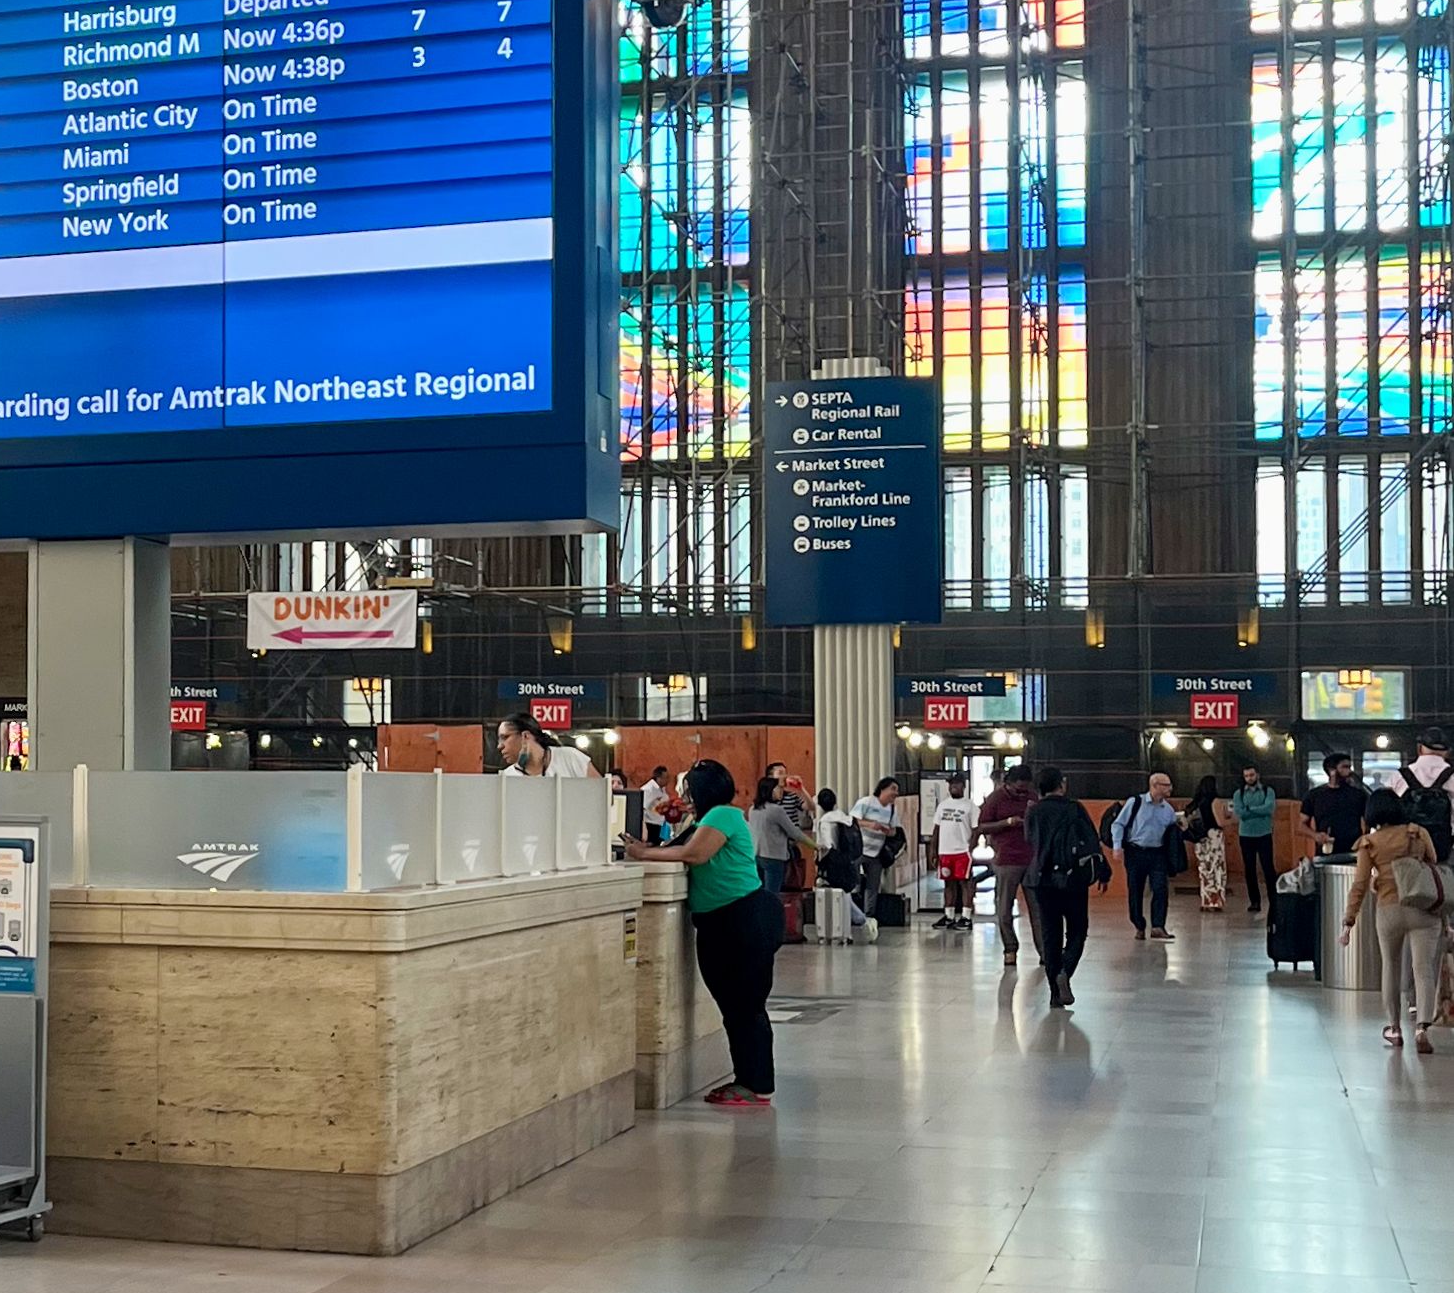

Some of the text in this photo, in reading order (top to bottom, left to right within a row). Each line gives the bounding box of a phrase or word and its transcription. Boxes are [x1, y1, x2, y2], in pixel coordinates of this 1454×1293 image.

[63, 4, 176, 33] Harrisburg
[63, 34, 172, 67] Richmond
[178, 32, 200, 55] M
[223, 27, 276, 50] Now
[281, 18, 345, 45] 4:36p
[411, 8, 426, 31] 7
[497, 0, 513, 23] 7
[62, 78, 139, 102] Boston
[223, 64, 277, 87] Now
[281, 55, 346, 81] 4:38p
[412, 45, 426, 68] 3
[496, 36, 514, 60] 4
[62, 107, 148, 136] Atlantic
[153, 103, 199, 130] City
[223, 98, 256, 121] On
[261, 93, 318, 117] Time
[62, 142, 129, 170] Miami
[223, 133, 256, 156] On
[261, 128, 318, 153] Time
[62, 173, 179, 208] Springfield
[223, 168, 256, 191] On
[261, 163, 318, 188] Time
[62, 216, 113, 238] New
[118, 209, 170, 233] York
[223, 203, 256, 226] On
[261, 198, 318, 223] Time
[76, 388, 119, 416] call
[126, 387, 163, 414] for
[169, 380, 266, 411] Amtrak
[274, 373, 407, 404] Northeast
[415, 364, 535, 401] Regional
[811, 392, 853, 406] SEPTA
[811, 404, 900, 422] Regional Rail
[811, 426, 882, 441] Car Rental
[791, 457, 885, 472] Market Street
[812, 479, 866, 492] Market-
[812, 492, 911, 507] Frankford Line
[812, 514, 896, 531] Trolley Lines
[812, 538, 851, 550] Buses
[272, 595, 390, 621] DUNKIN'
[170, 686, 218, 698] th Street
[517, 683, 585, 695] 30th Street
[910, 680, 983, 693] 30th Street
[1175, 677, 1252, 691] 30th Street
[170, 707, 203, 723] EXIT
[532, 705, 568, 722] EXIT
[927, 704, 965, 722] EXIT
[1193, 701, 1234, 720] EXIT
[191, 843, 259, 851] AMTRAK
